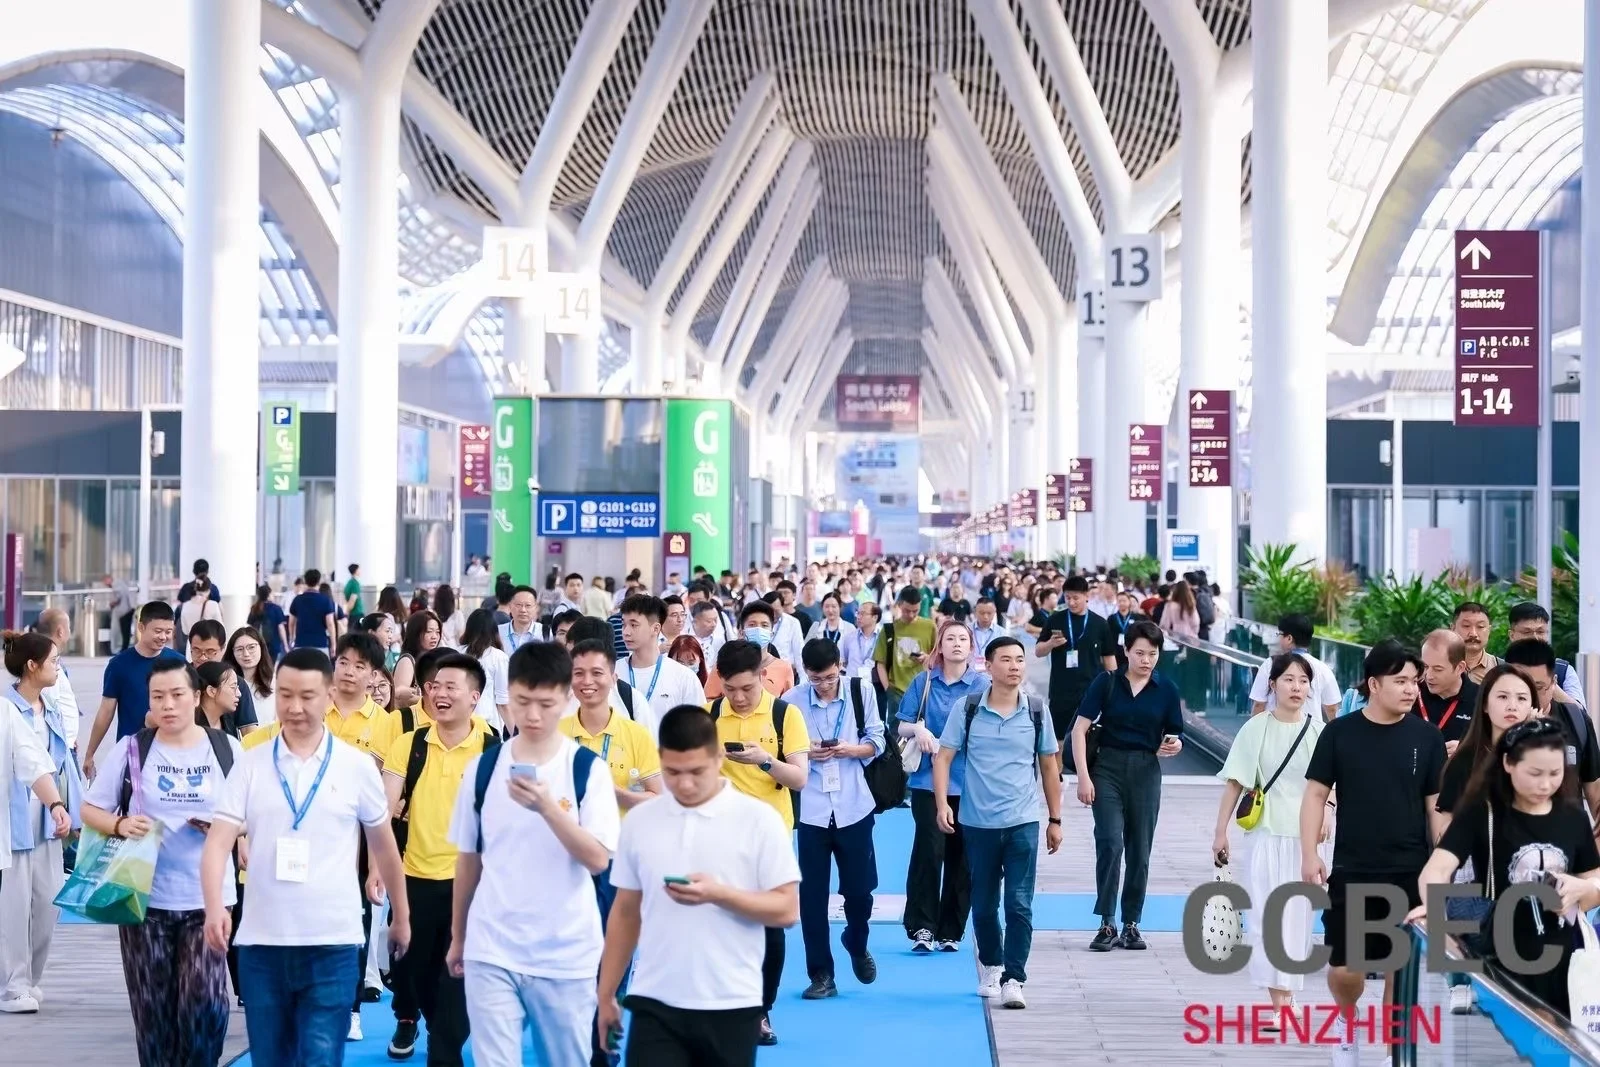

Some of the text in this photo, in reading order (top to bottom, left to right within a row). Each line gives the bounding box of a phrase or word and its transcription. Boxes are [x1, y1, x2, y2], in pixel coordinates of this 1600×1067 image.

[497, 241, 536, 282] 14
[1111, 247, 1150, 287] 13
[558, 287, 591, 320] 14
[1460, 300, 1505, 310] South Lobby
[1463, 342, 1473, 353] P
[1481, 373, 1499, 383] Halls
[845, 398, 911, 415] South Lobby
[1460, 388, 1513, 415] 1-14
[275, 407, 289, 424] P
[495, 406, 514, 449] G
[693, 411, 719, 454] G
[1191, 466, 1219, 483] 1-14
[551, 503, 568, 531] P
[157, 764, 171, 774] YOU
[186, 767, 192, 775] A
[193, 764, 211, 775] VERY
